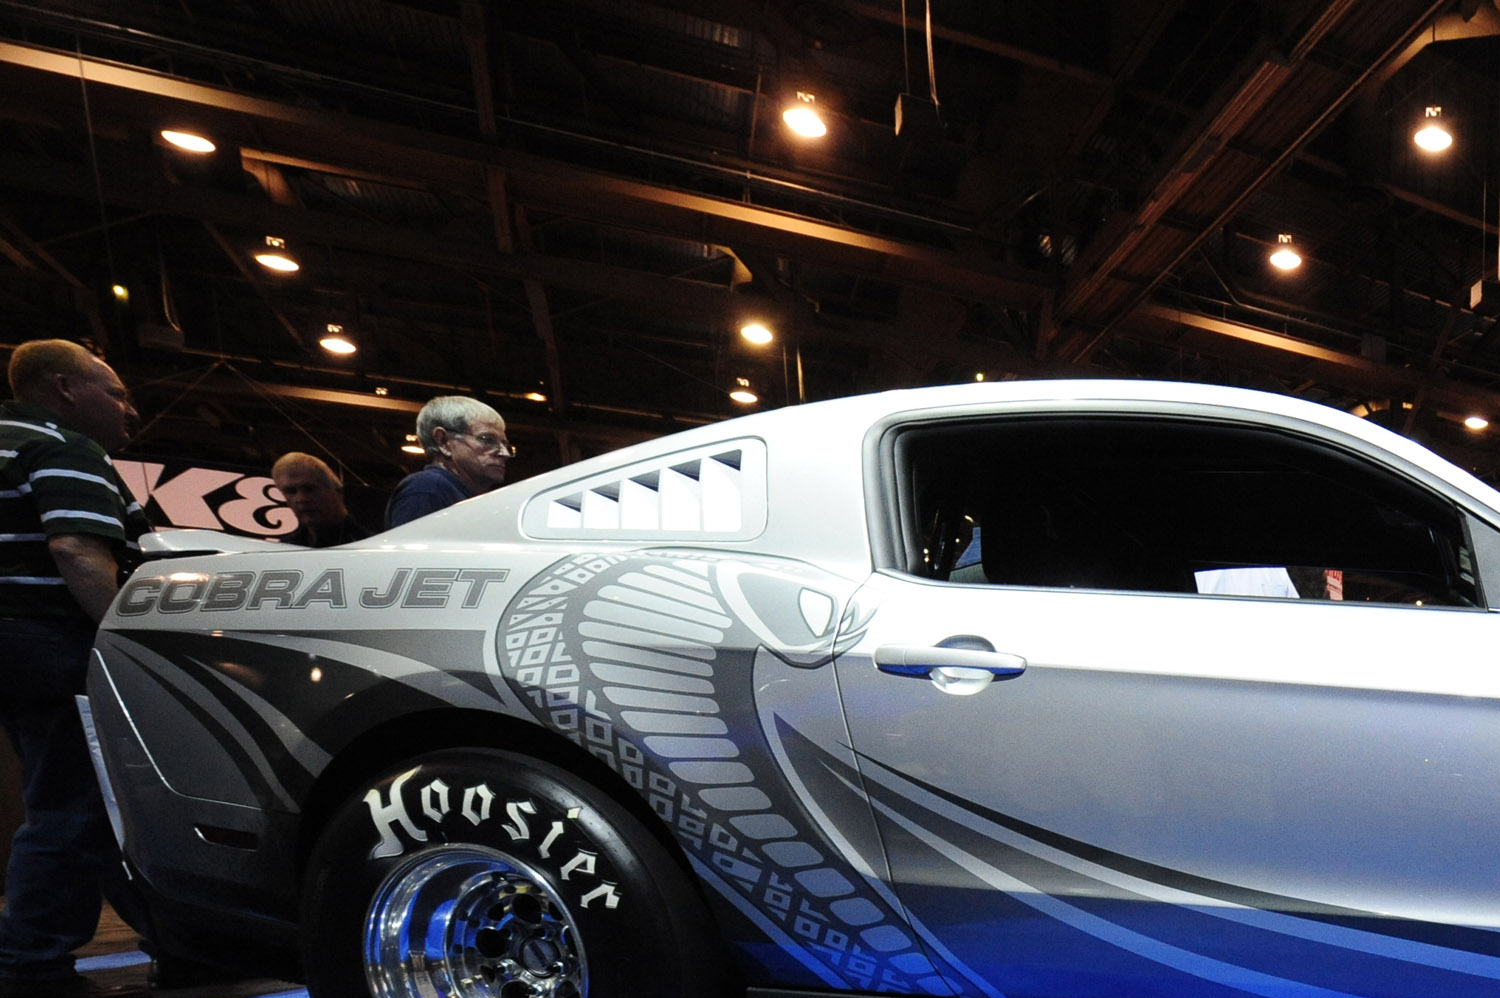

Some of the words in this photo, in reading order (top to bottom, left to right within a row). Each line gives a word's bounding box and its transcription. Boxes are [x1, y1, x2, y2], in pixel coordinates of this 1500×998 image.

[116, 568, 347, 616] COBRA
[358, 568, 511, 609] JET
[362, 765, 622, 909] Hoosier
